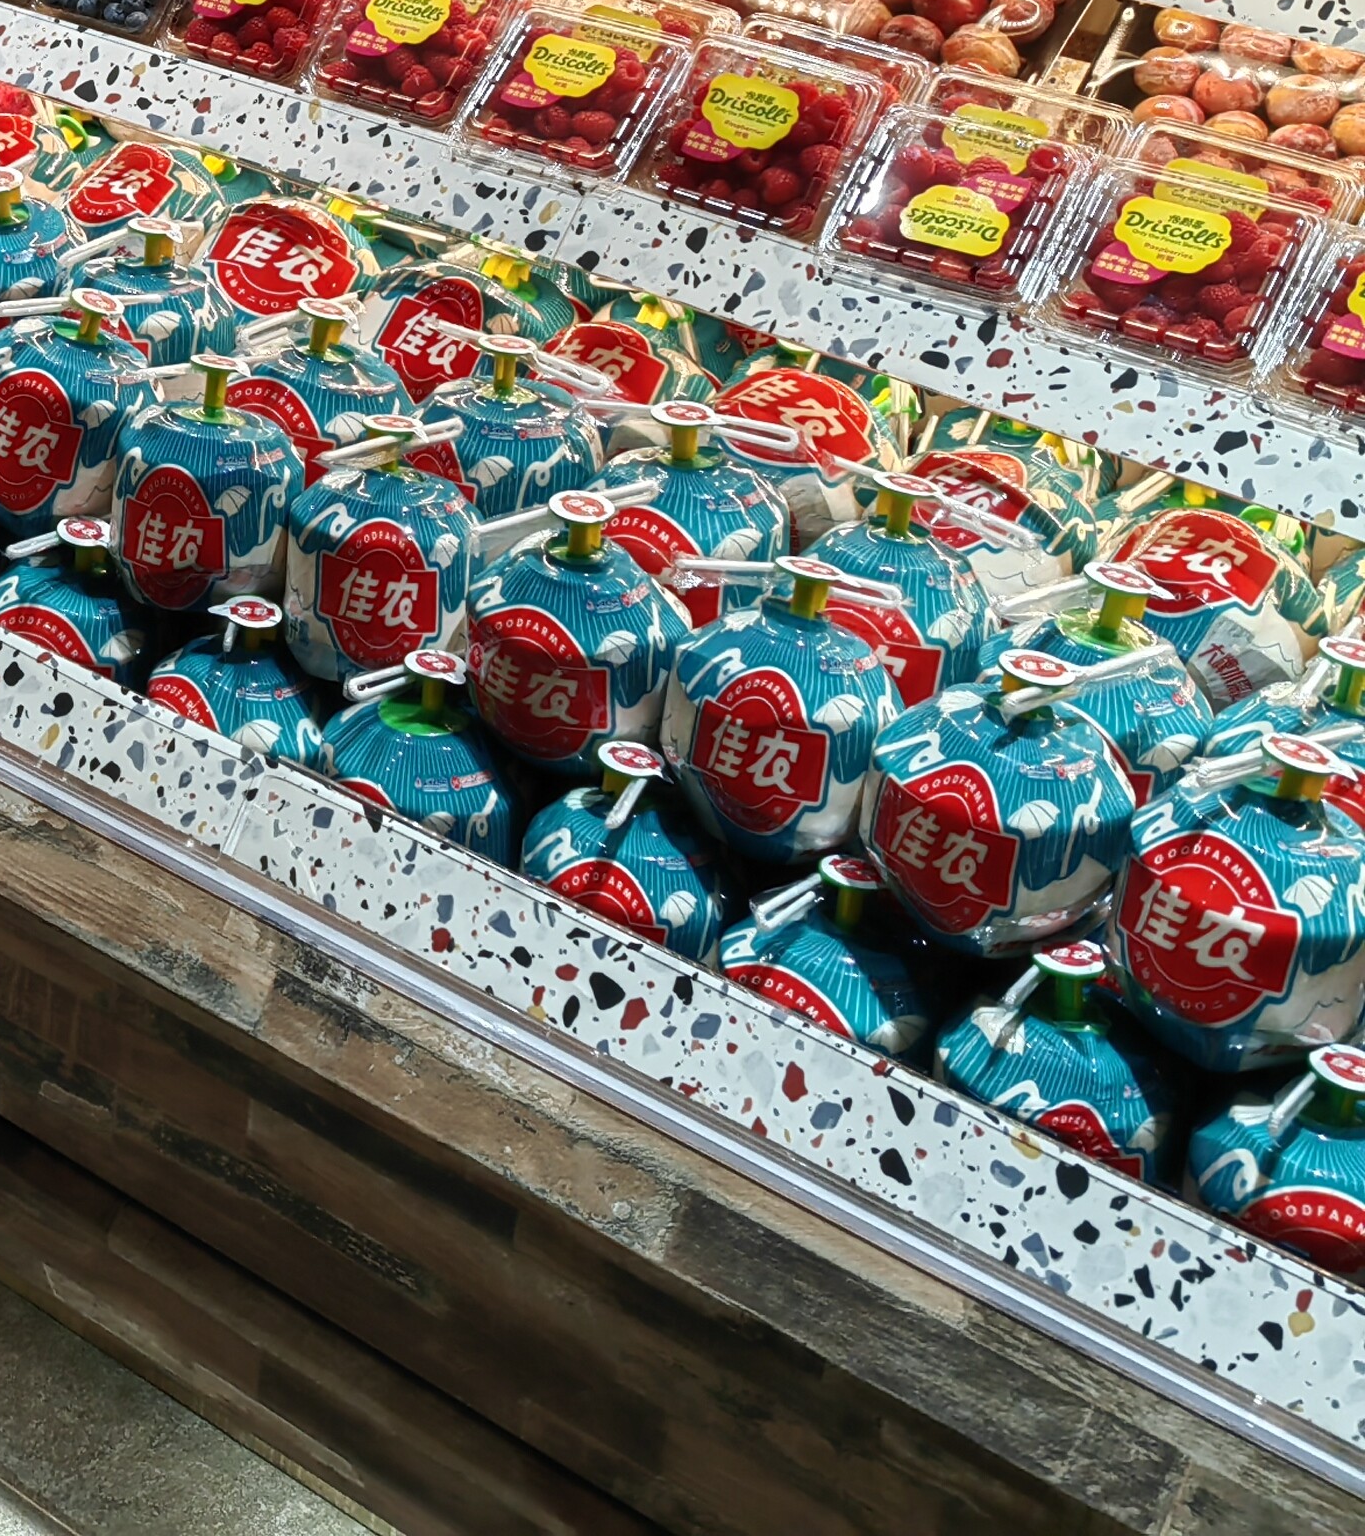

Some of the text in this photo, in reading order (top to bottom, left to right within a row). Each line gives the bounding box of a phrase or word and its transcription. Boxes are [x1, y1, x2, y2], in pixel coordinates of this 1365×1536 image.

[533, 46, 610, 76] Driscoll's
[709, 88, 793, 124] Driscoll's
[907, 208, 1000, 242] Driscoll's
[1124, 211, 1227, 249] Driscoll's
[226, 225, 334, 296] 佳农
[393, 309, 467, 375] 佳农
[730, 374, 844, 452] 佳农
[136, 510, 204, 573] 佳农
[1140, 525, 1250, 586] 佳农
[337, 567, 419, 630] 佳农
[0, 616, 80, 658] GOODFARMER
[478, 644, 580, 725] 佳农
[726, 679, 794, 722] GOODFARMER
[706, 714, 800, 795] 佳农
[919, 774, 989, 824] GOODFARMER
[889, 805, 988, 895] 佳农
[1154, 845, 1262, 900] GOODFARMER
[562, 871, 645, 920] GOODFARMER
[1133, 878, 1267, 981] 佳农
